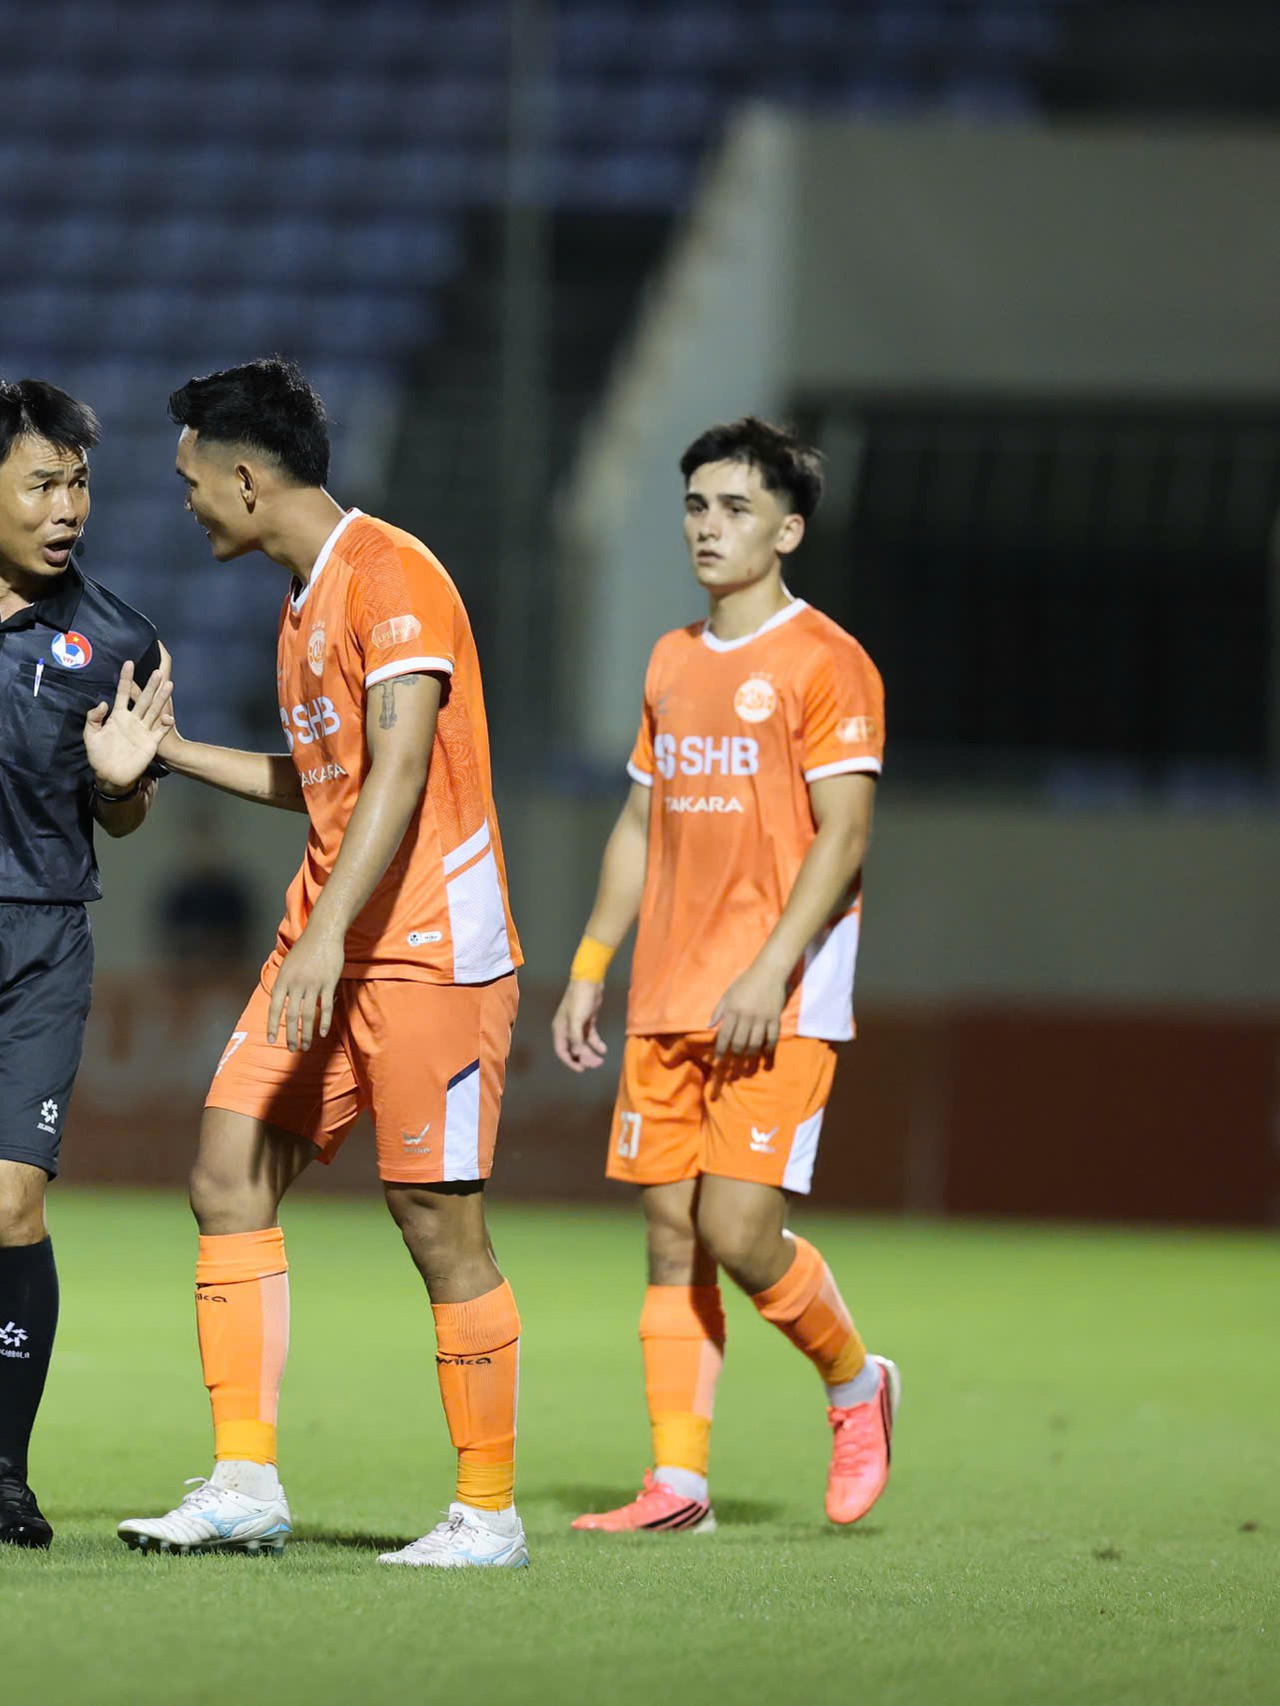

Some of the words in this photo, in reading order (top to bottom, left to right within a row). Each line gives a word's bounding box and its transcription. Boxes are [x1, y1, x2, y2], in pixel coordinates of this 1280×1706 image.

[291, 696, 341, 745] SHB
[680, 735, 759, 776] SHB
[297, 762, 348, 788] AKARA
[664, 795, 744, 813] TAKARA
